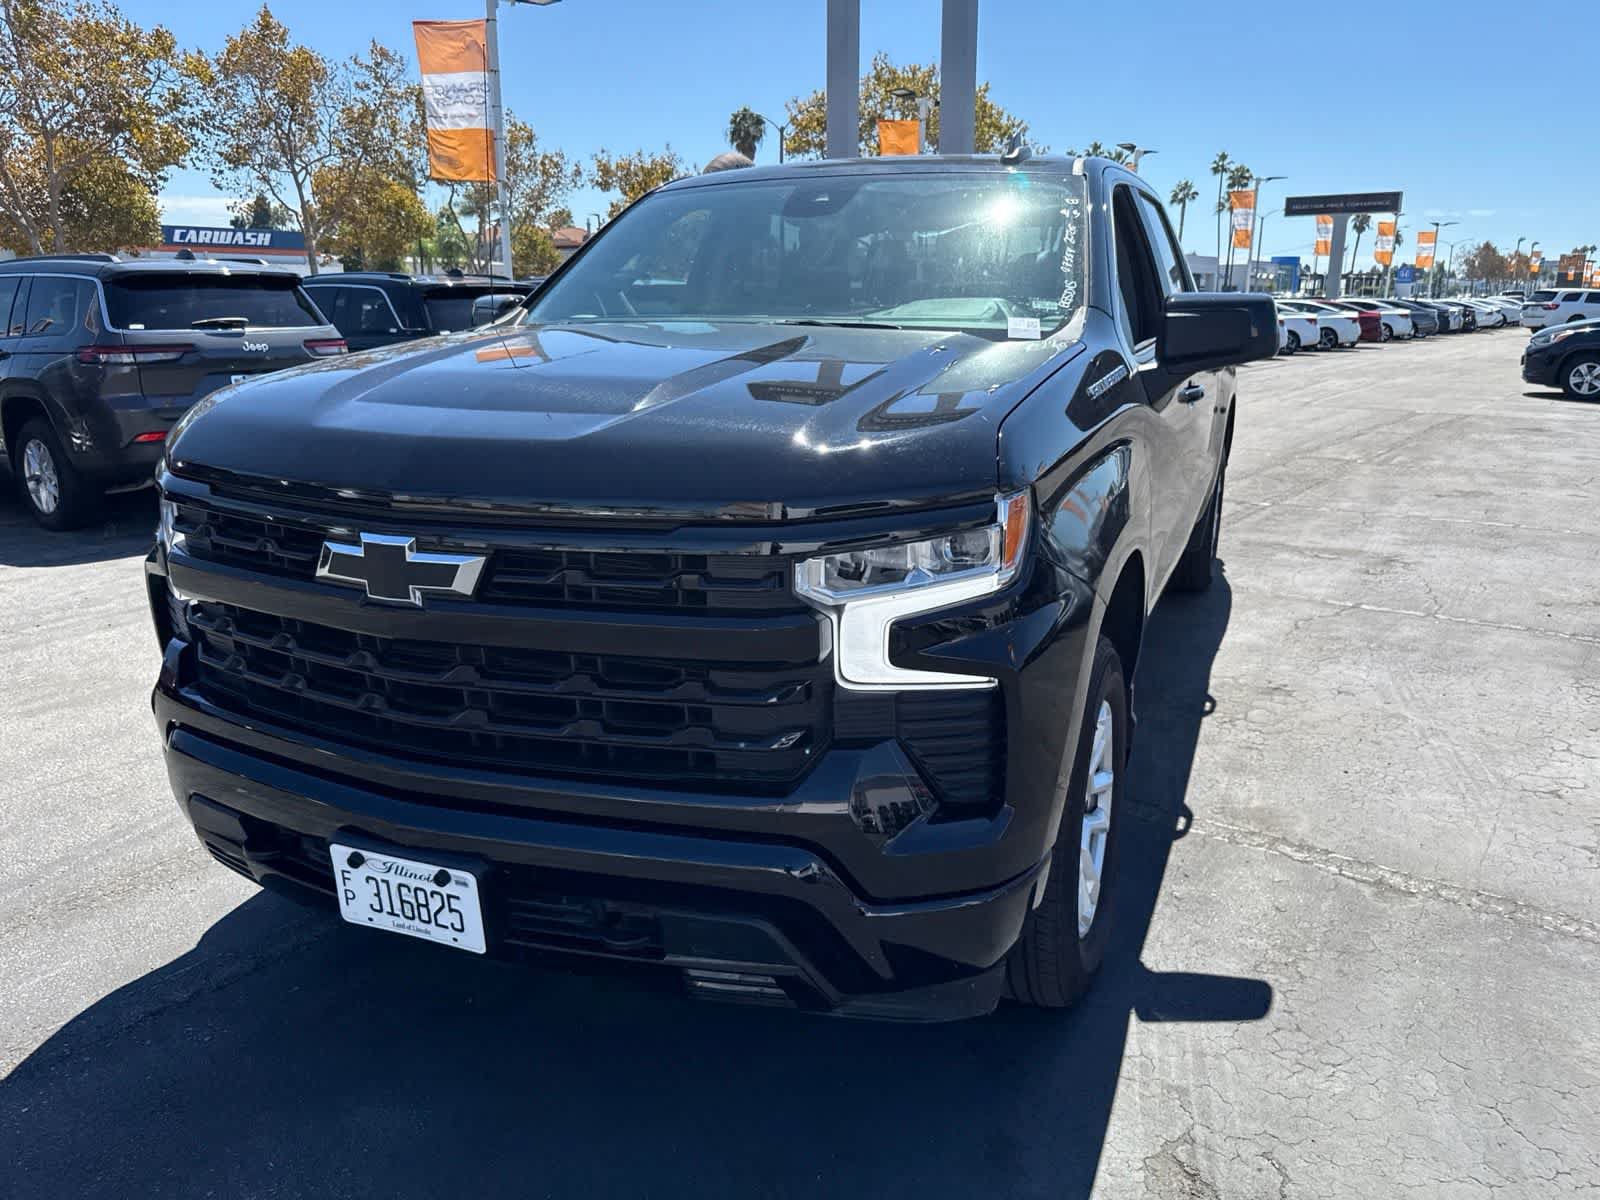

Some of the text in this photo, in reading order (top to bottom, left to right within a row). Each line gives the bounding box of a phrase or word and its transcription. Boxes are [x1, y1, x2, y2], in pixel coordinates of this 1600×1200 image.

[172, 229, 272, 246] CARWASH
[242, 340, 269, 352] Jeep
[340, 869, 352, 887] F
[381, 860, 435, 884] Illinoi
[343, 888, 356, 906] P
[365, 875, 465, 933] 316825
